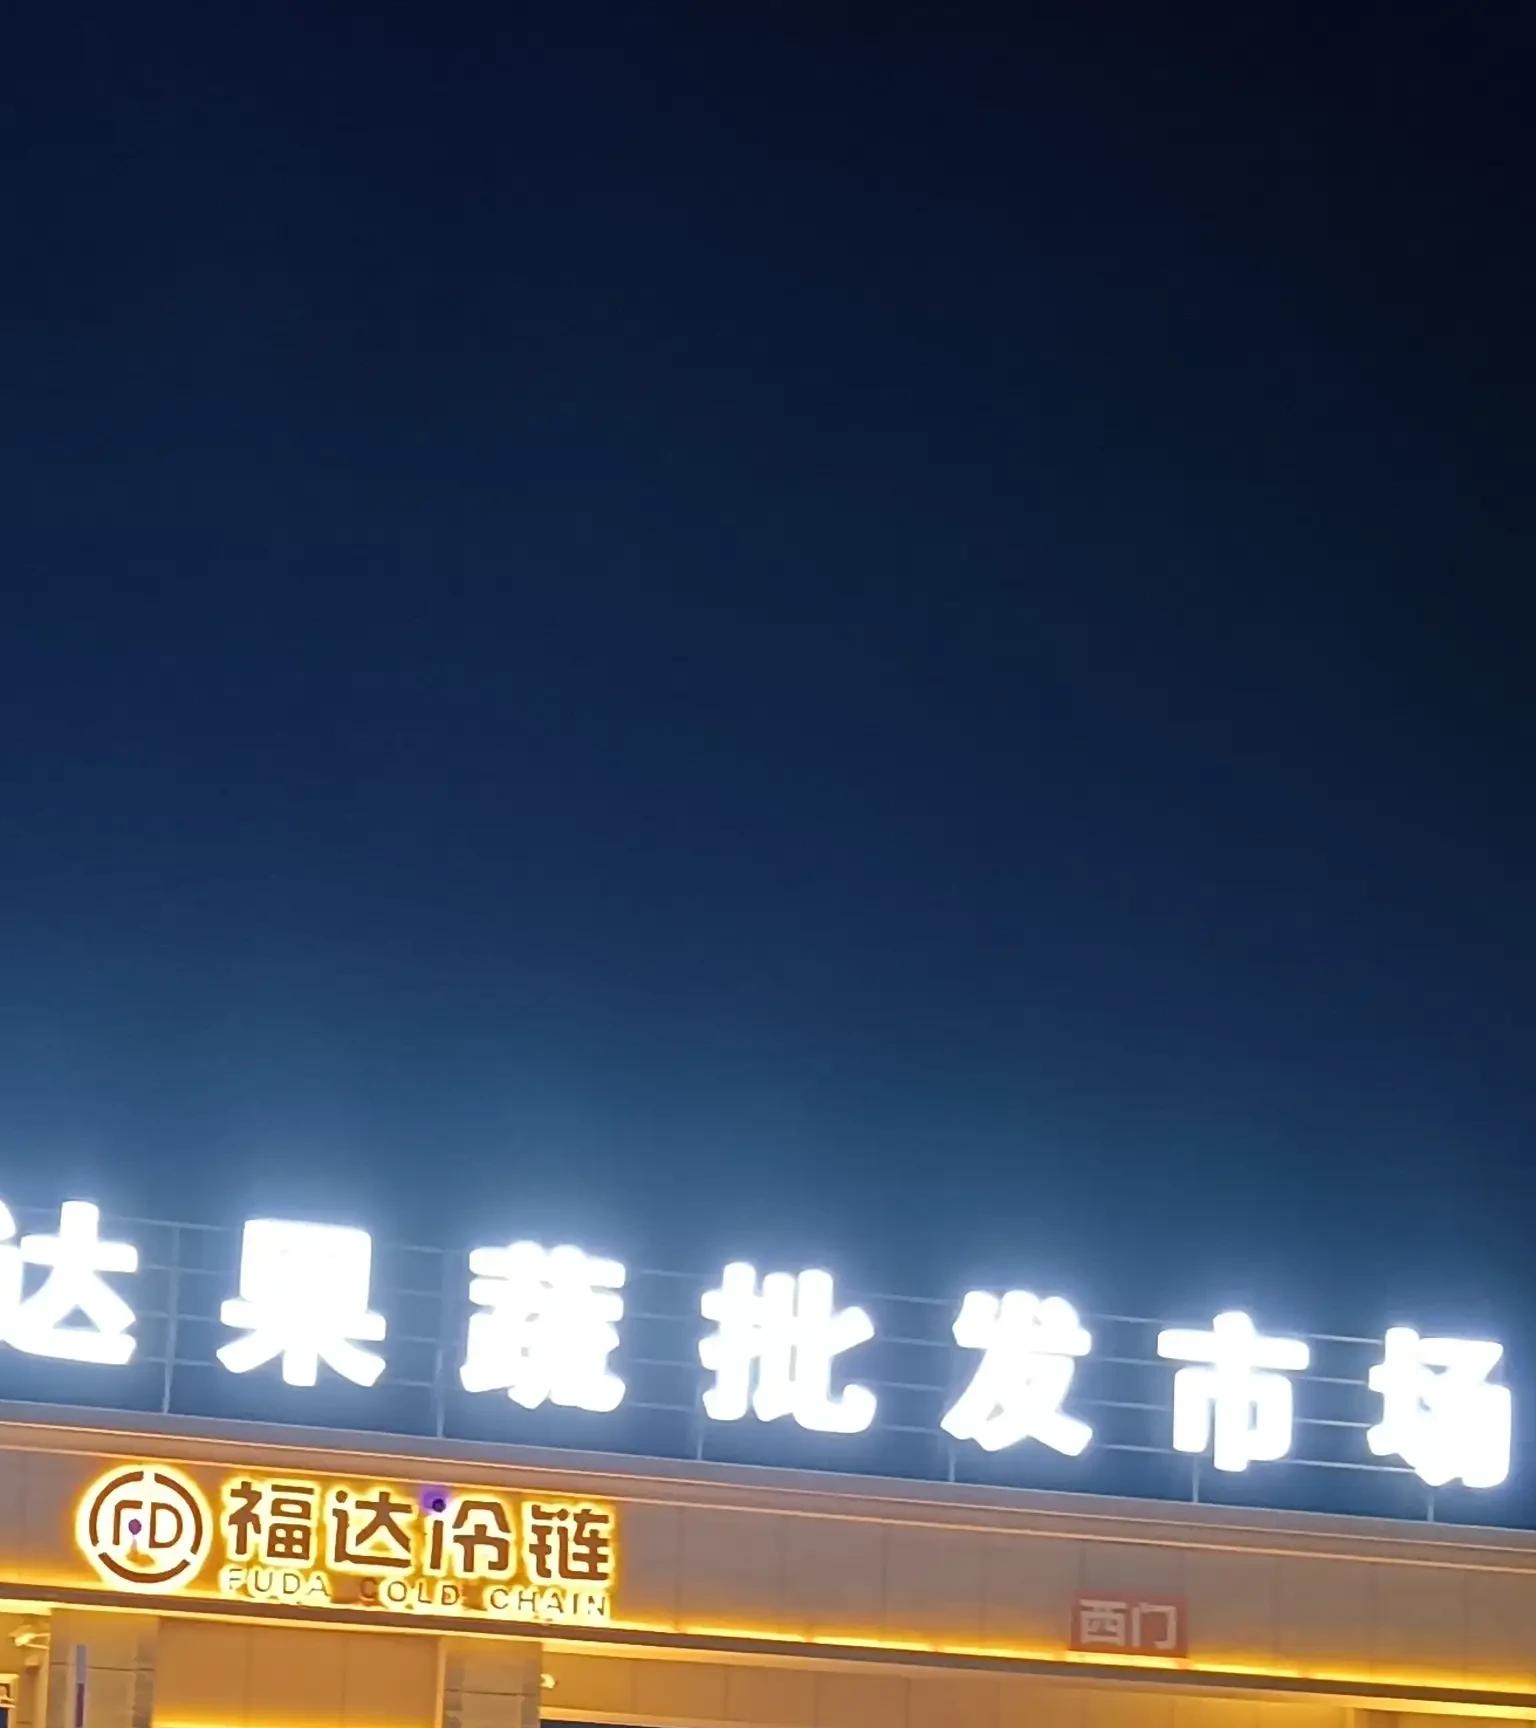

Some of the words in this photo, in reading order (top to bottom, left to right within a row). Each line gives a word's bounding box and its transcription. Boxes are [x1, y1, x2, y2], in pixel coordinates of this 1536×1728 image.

[227, 1480, 611, 1582] 福达冷链
[228, 1568, 332, 1597] FUDA
[359, 1576, 461, 1606] COLD
[489, 1587, 607, 1617] CHAIN
[1078, 1598, 1178, 1650] 西门
